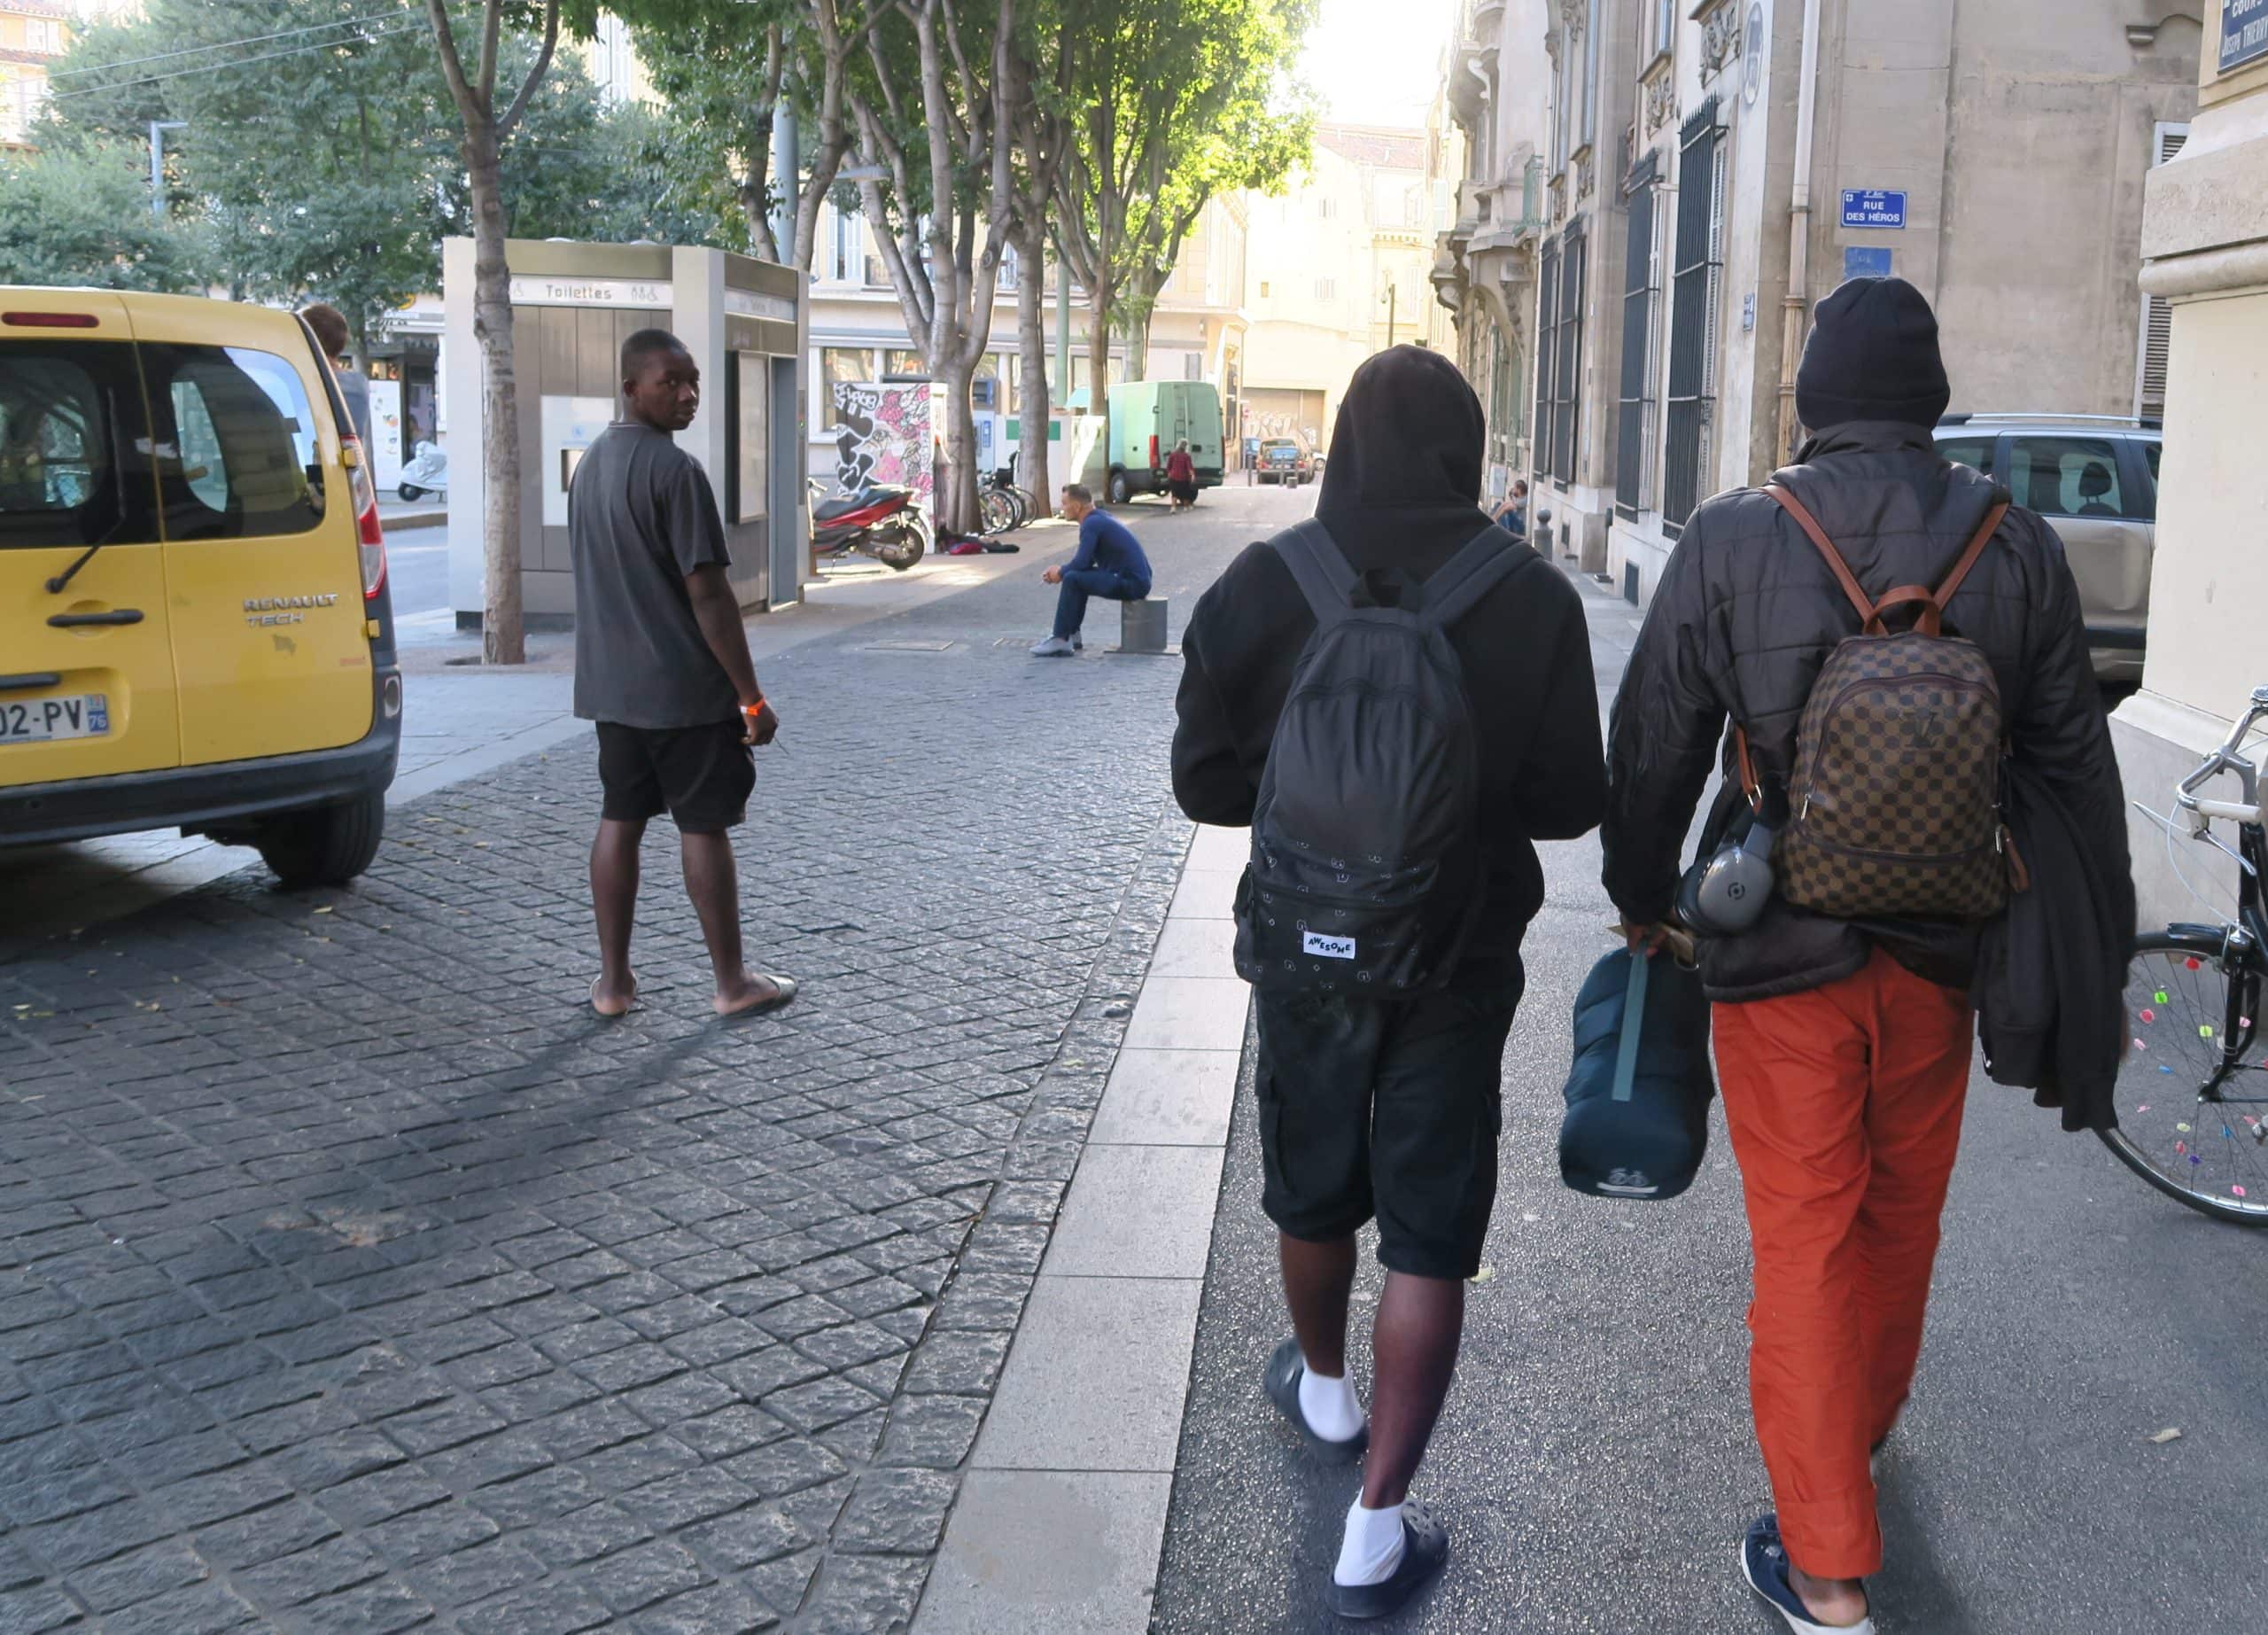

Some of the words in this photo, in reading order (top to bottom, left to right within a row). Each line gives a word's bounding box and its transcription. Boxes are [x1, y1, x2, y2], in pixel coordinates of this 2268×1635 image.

[1863, 201, 1884, 210] RUE
[1846, 212, 1865, 221] DES
[1868, 211, 1900, 222] HÉROS
[546, 284, 612, 300] Toilettes
[244, 593, 338, 611] RENAULT
[245, 612, 304, 627] TECH
[1309, 937, 1351, 954] AWESOME
